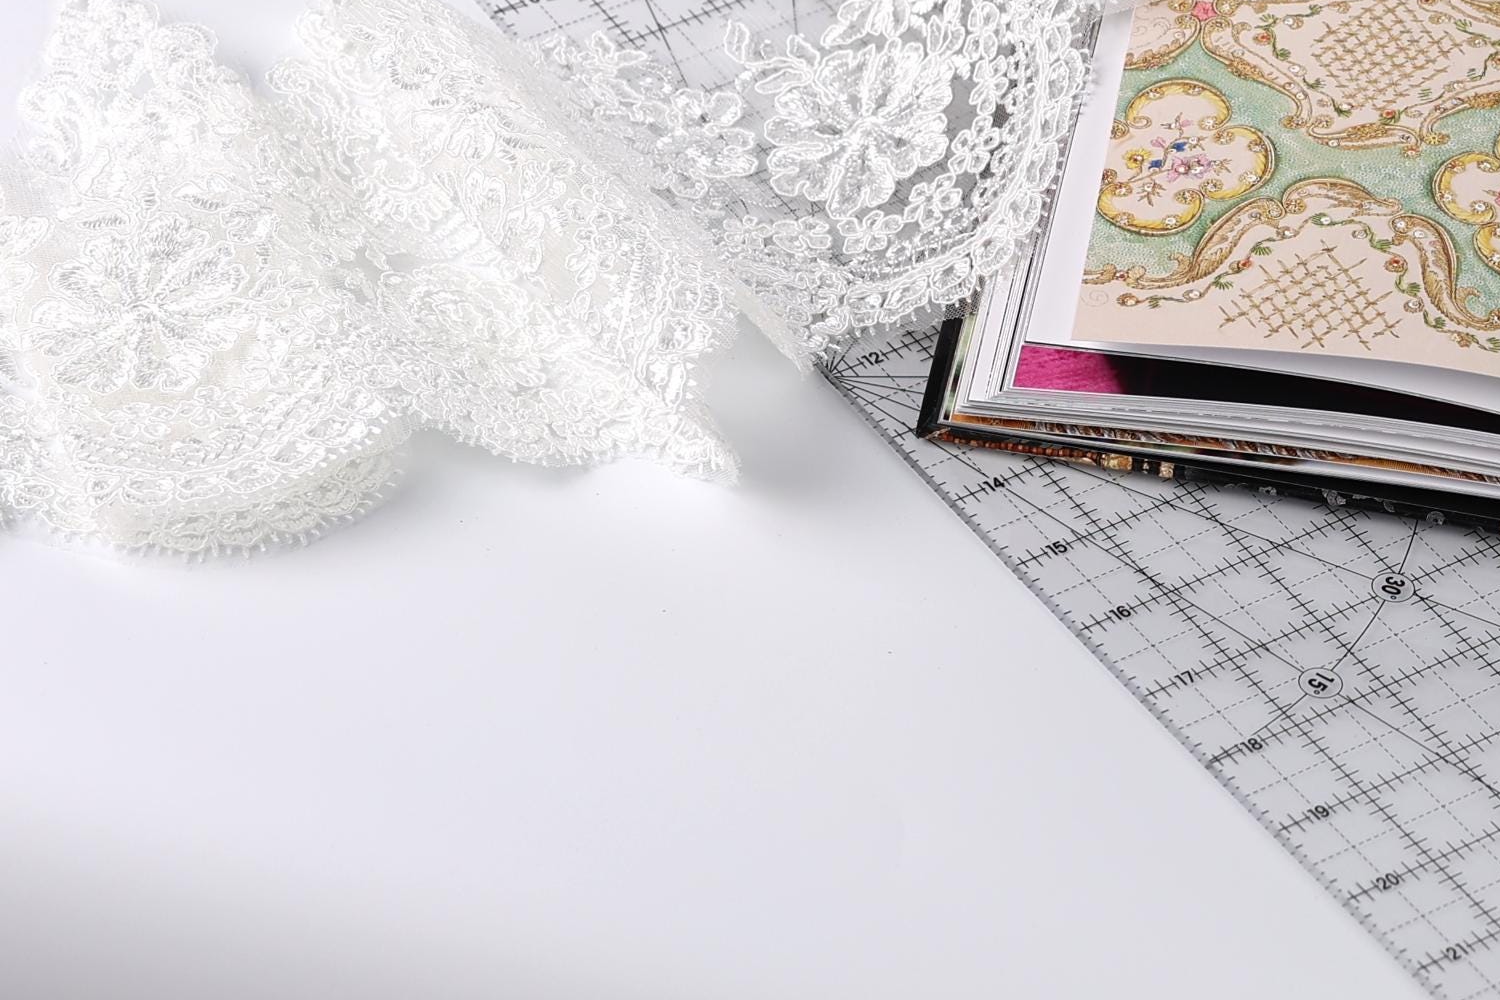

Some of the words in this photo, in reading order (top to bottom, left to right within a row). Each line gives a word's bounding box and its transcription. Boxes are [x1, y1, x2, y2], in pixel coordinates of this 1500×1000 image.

[861, 351, 884, 366] 12
[983, 476, 1006, 492] 14
[1045, 540, 1068, 555] 15
[1381, 576, 1405, 600] 30°
[1109, 605, 1132, 620] 16
[1174, 670, 1195, 686] 17
[1240, 737, 1263, 753] 18
[1306, 804, 1330, 820] 19
[1376, 873, 1400, 890] 20
[1446, 943, 1469, 960] 21
